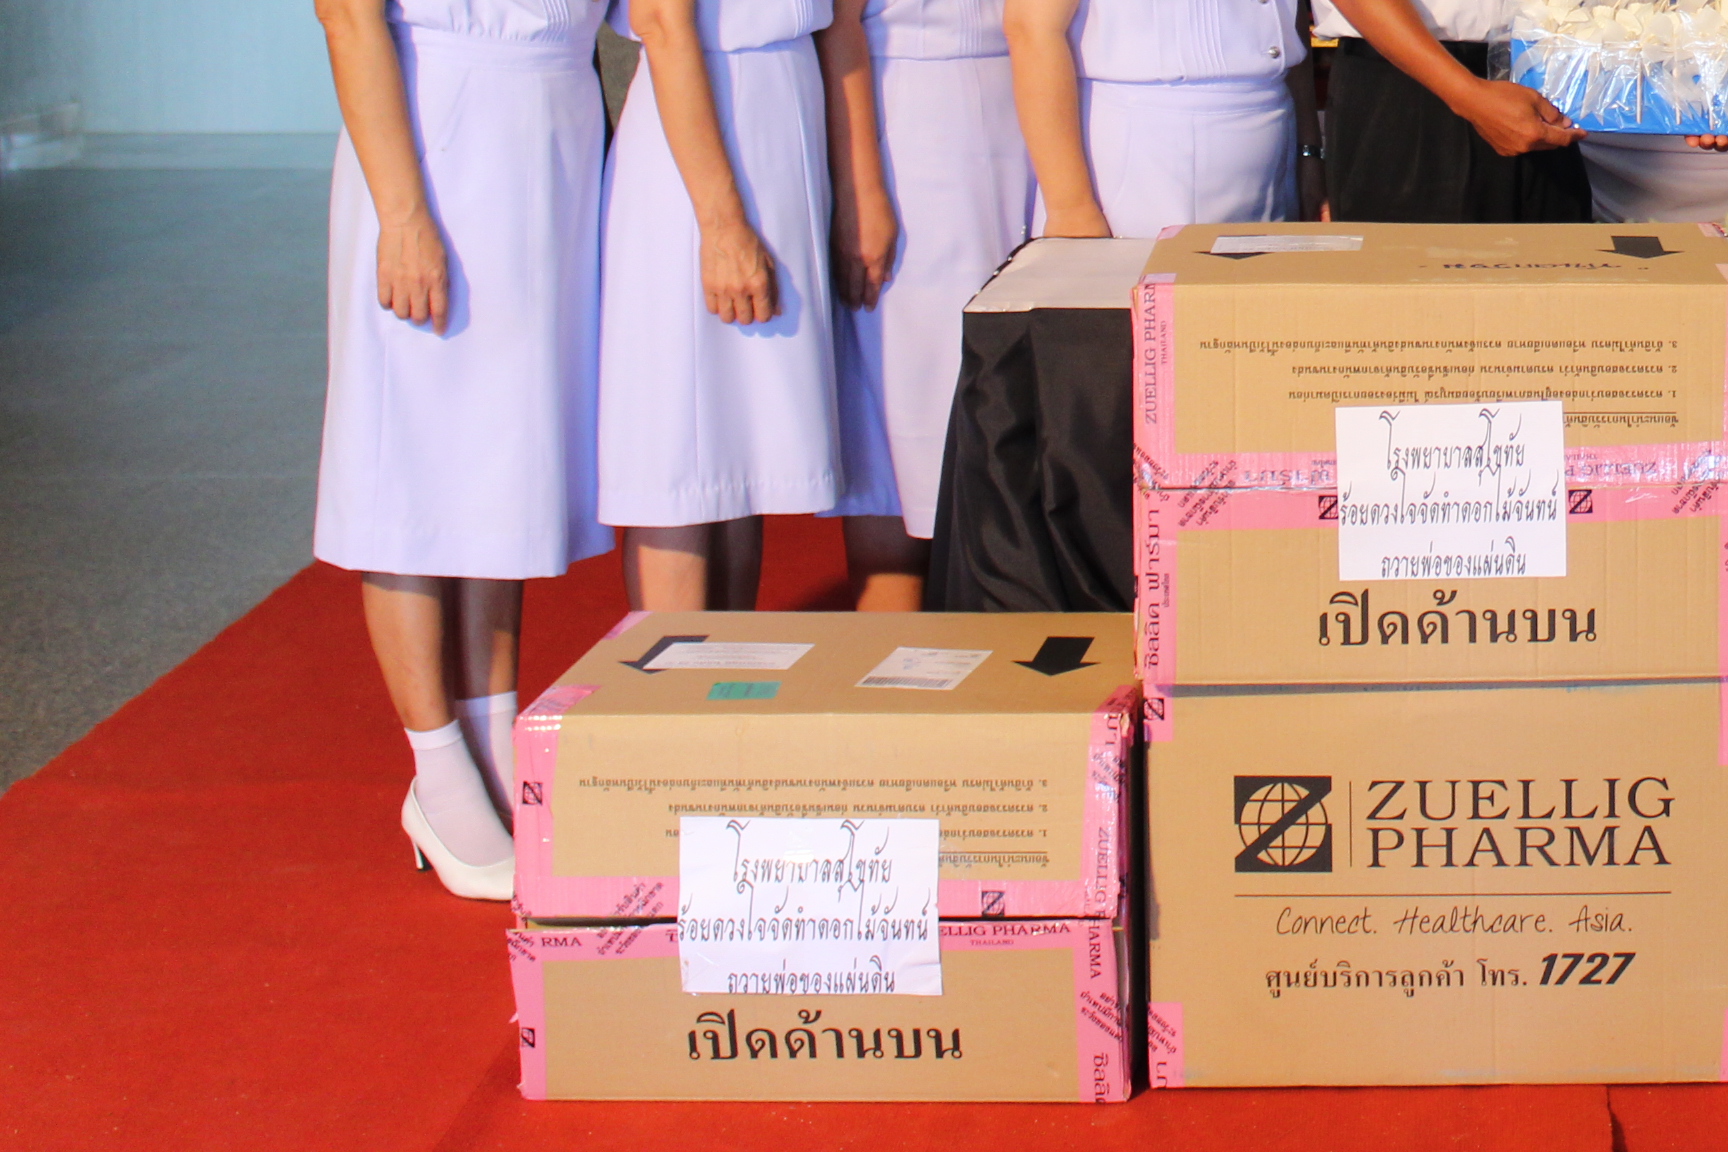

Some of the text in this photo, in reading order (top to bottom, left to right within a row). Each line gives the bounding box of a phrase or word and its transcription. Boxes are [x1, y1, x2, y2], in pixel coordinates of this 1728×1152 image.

[1144, 348, 1157, 425] ZUELLIG
[1379, 408, 1525, 486] โรงพยาบาลสุโขทัย
[1340, 466, 1559, 525] ร้อยดวงใจจัดทำดอกไม้จันทน์
[1144, 509, 1160, 591] ฟาร์มา
[1381, 536, 1526, 578] ถวายพ่อของแผ่นดิน
[1144, 603, 1160, 669] ซิลลิค
[1319, 589, 1597, 646] เปิดด้านบน
[1366, 777, 1675, 821] ZUELLIG
[726, 820, 893, 902] โรงพยาบาลสุโขทัย
[1366, 825, 1672, 868] PHARMA
[677, 880, 931, 941] ร้อยดวงใจจัดทำดอกไม้จันทน์
[939, 923, 1071, 936] ELLIG PHARMA
[1276, 905, 1633, 936] Connect. Healthcare. Asia.
[541, 937, 582, 947] RMA
[727, 955, 895, 994] ถวายพ่อของแผ่นดิน
[1265, 952, 1636, 998] ศูนย์บริการลูกค้า โทร. 1727
[688, 1008, 963, 1060] เปิดด้านบน
